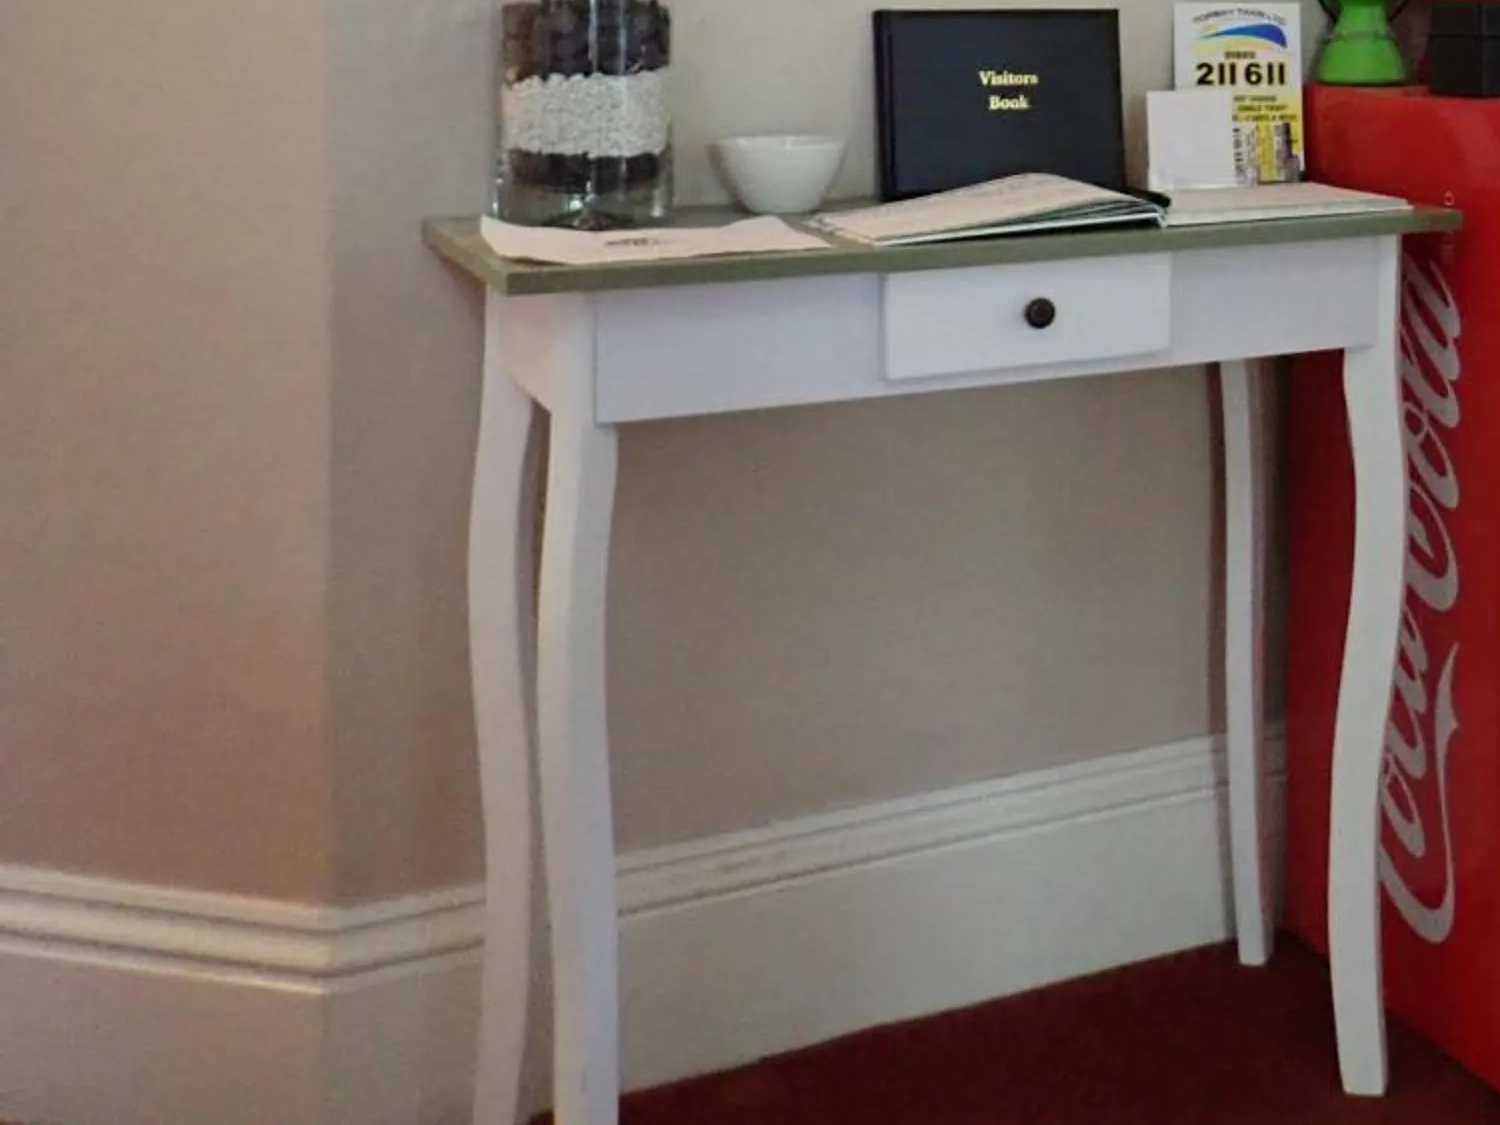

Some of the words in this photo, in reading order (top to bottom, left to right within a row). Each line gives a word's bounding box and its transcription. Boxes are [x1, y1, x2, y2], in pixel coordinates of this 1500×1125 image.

[979, 70, 1038, 86] Visitors
[988, 95, 1031, 110] Book
[1377, 253, 1461, 942] CocaCola
